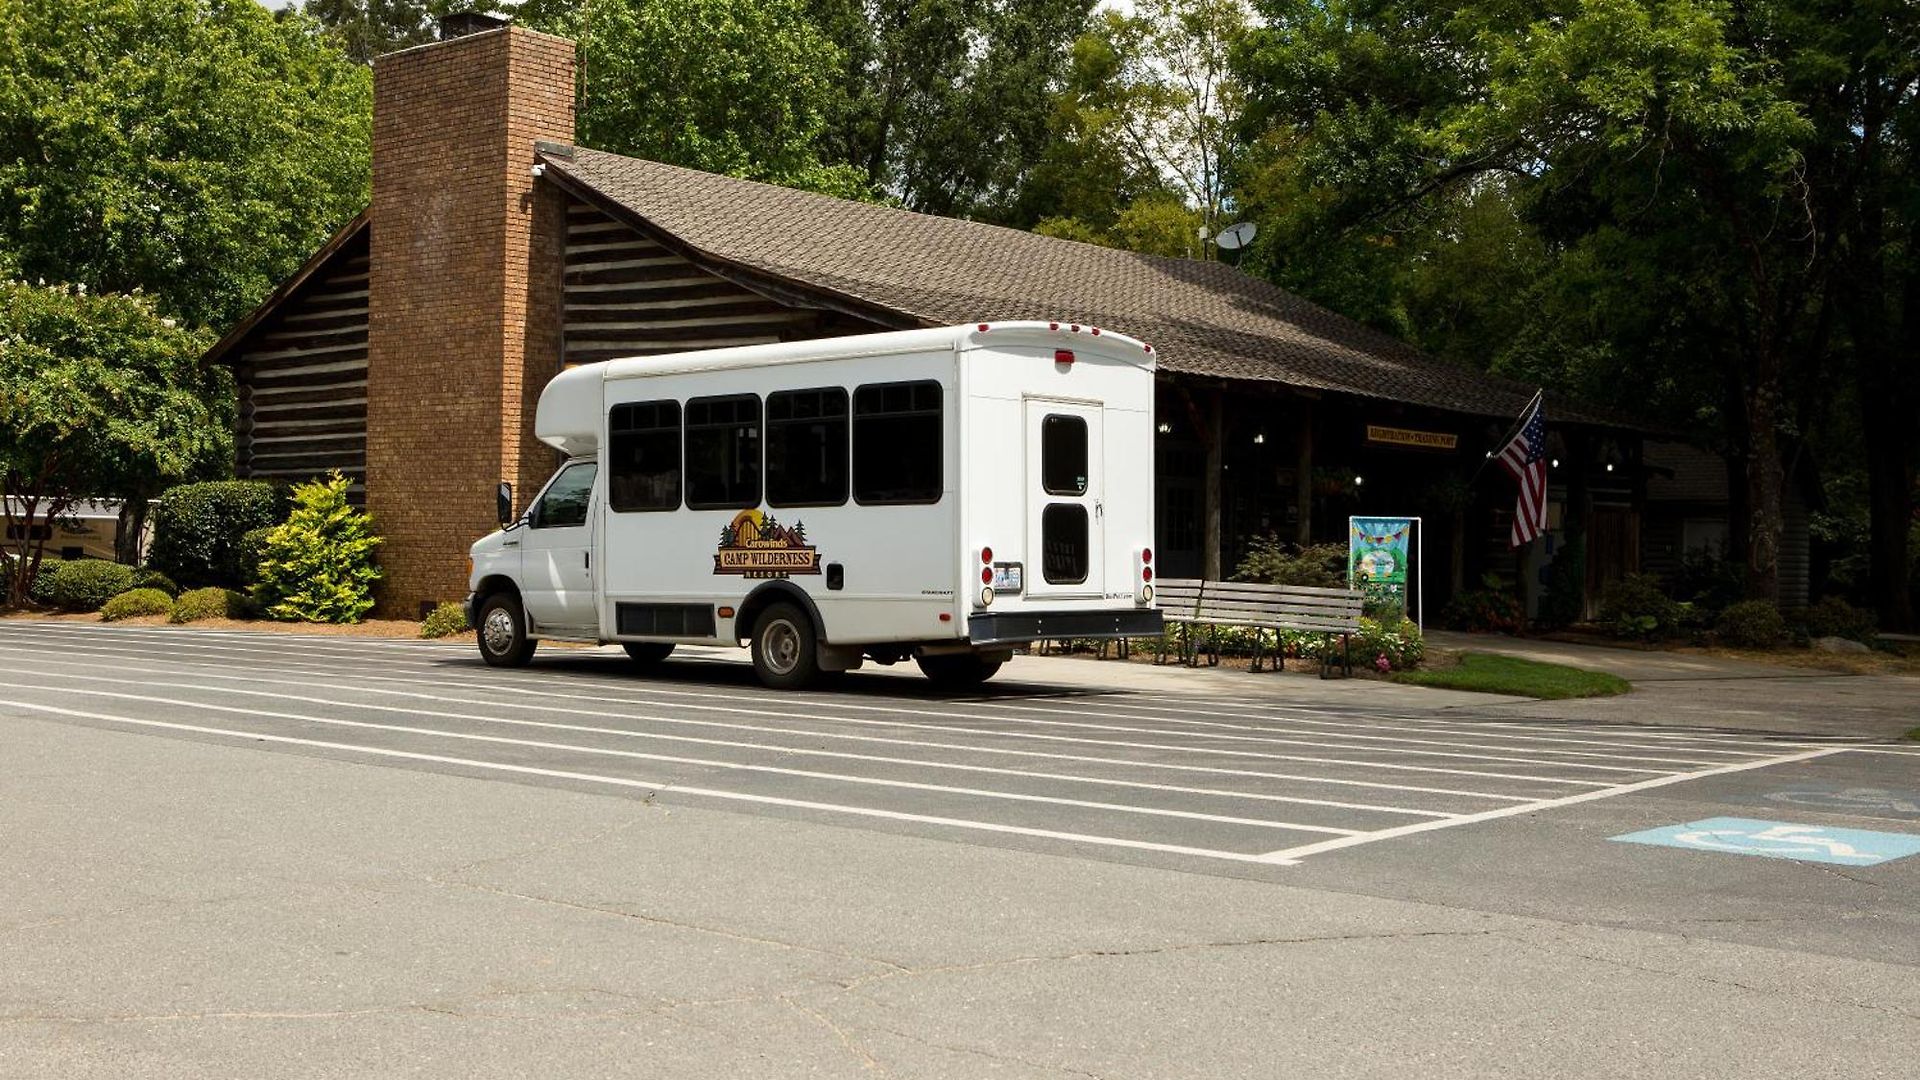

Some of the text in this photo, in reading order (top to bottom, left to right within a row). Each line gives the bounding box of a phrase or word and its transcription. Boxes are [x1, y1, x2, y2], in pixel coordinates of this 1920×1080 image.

[745, 538, 788, 549] Carowinds
[724, 552, 810, 565] CAMP WILDERNESS
